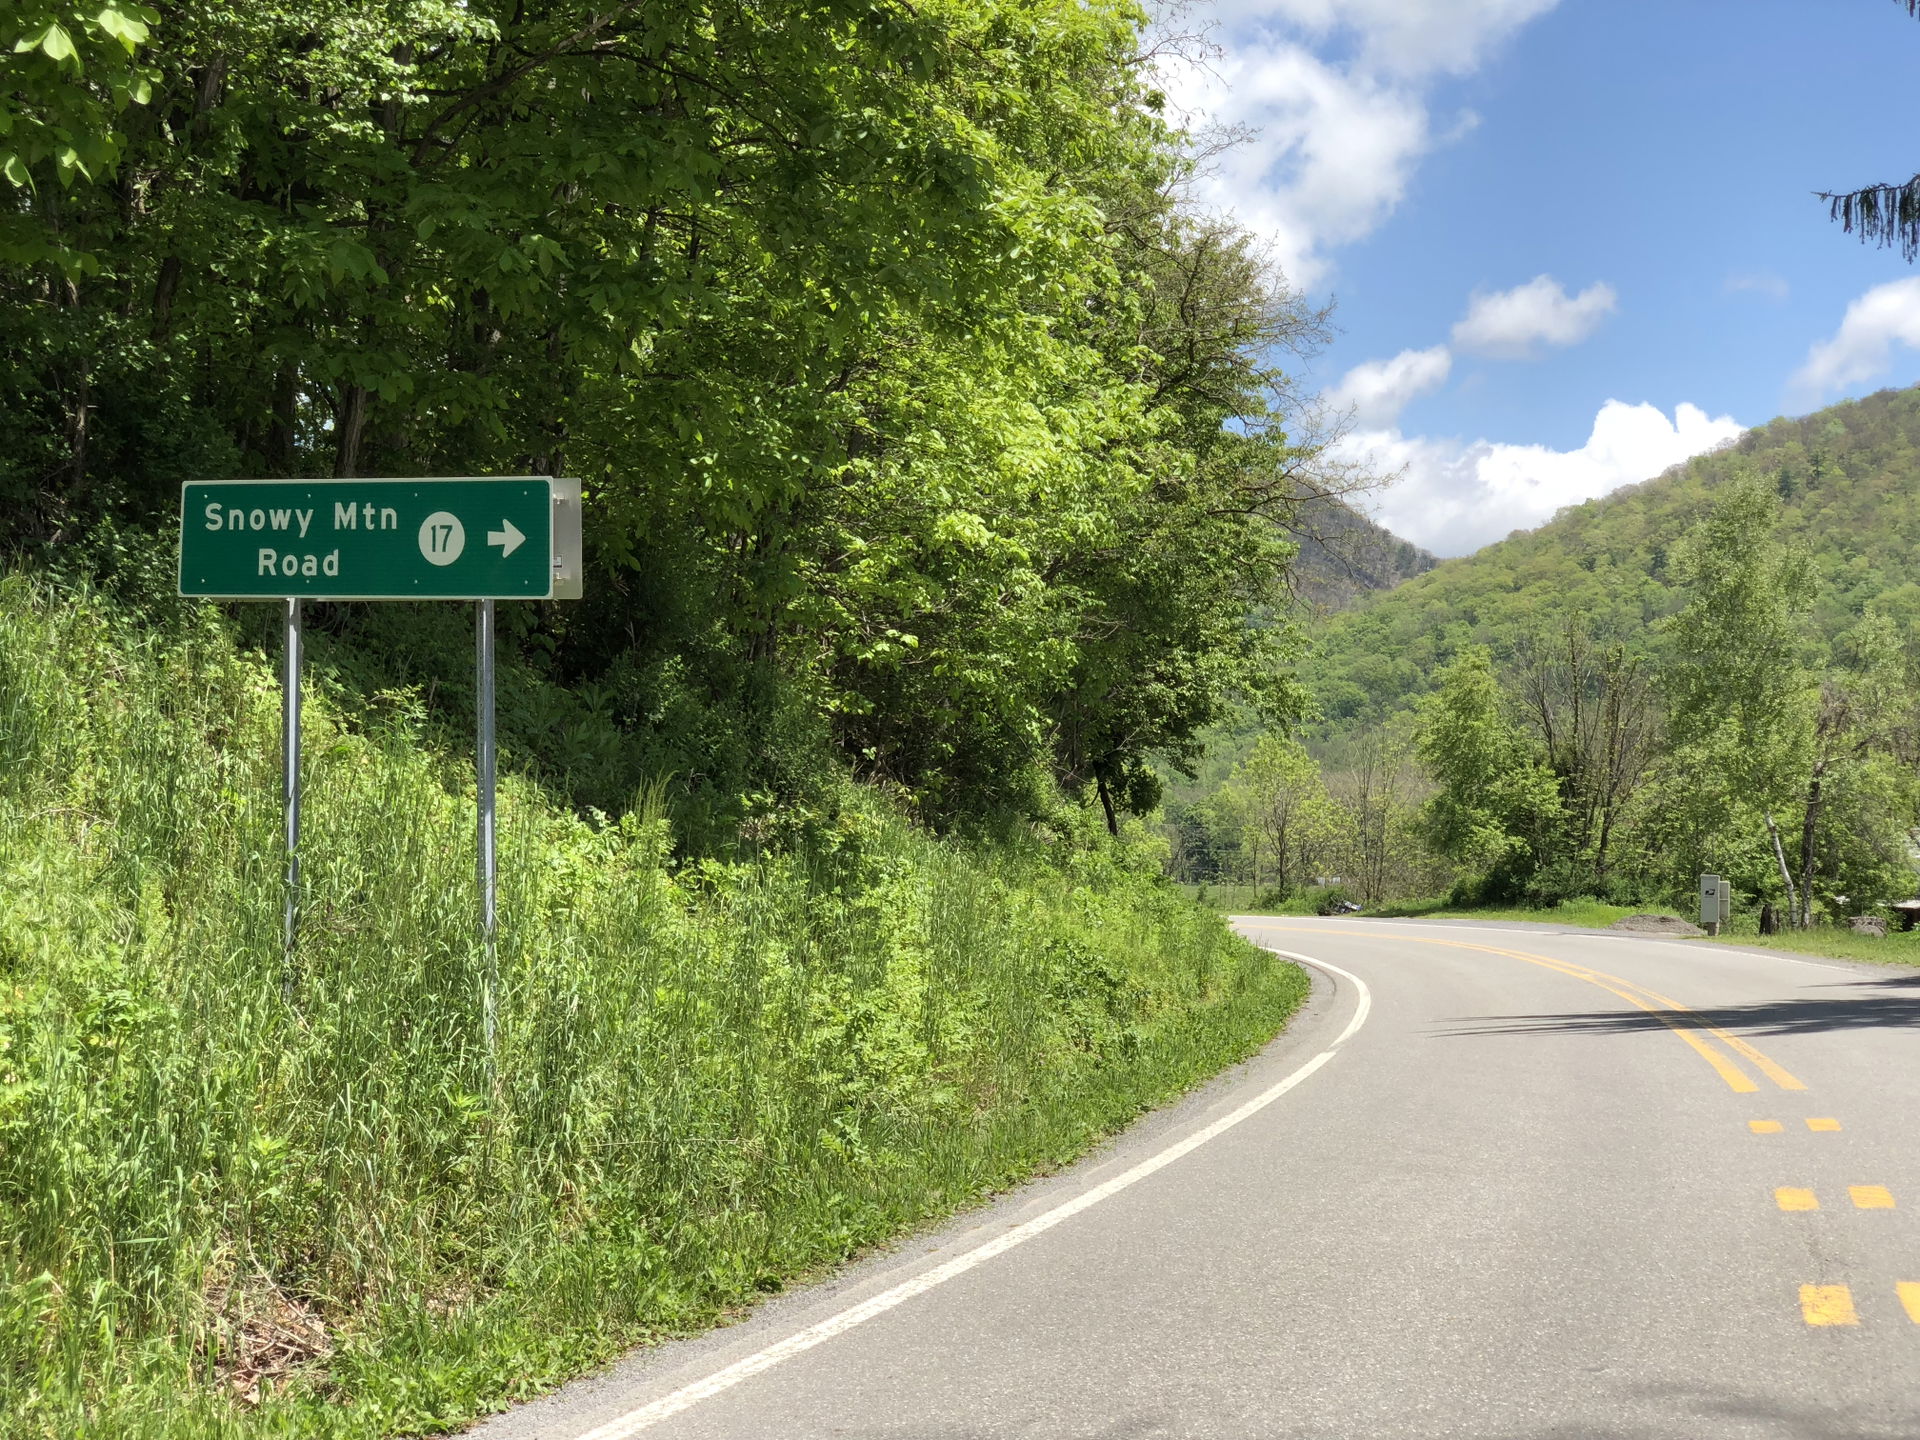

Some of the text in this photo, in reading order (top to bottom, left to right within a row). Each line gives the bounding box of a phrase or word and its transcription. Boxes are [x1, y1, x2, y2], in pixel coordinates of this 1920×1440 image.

[205, 502, 397, 537] Snowy Mtn
[431, 524, 453, 552] 17
[258, 548, 339, 576] Road
